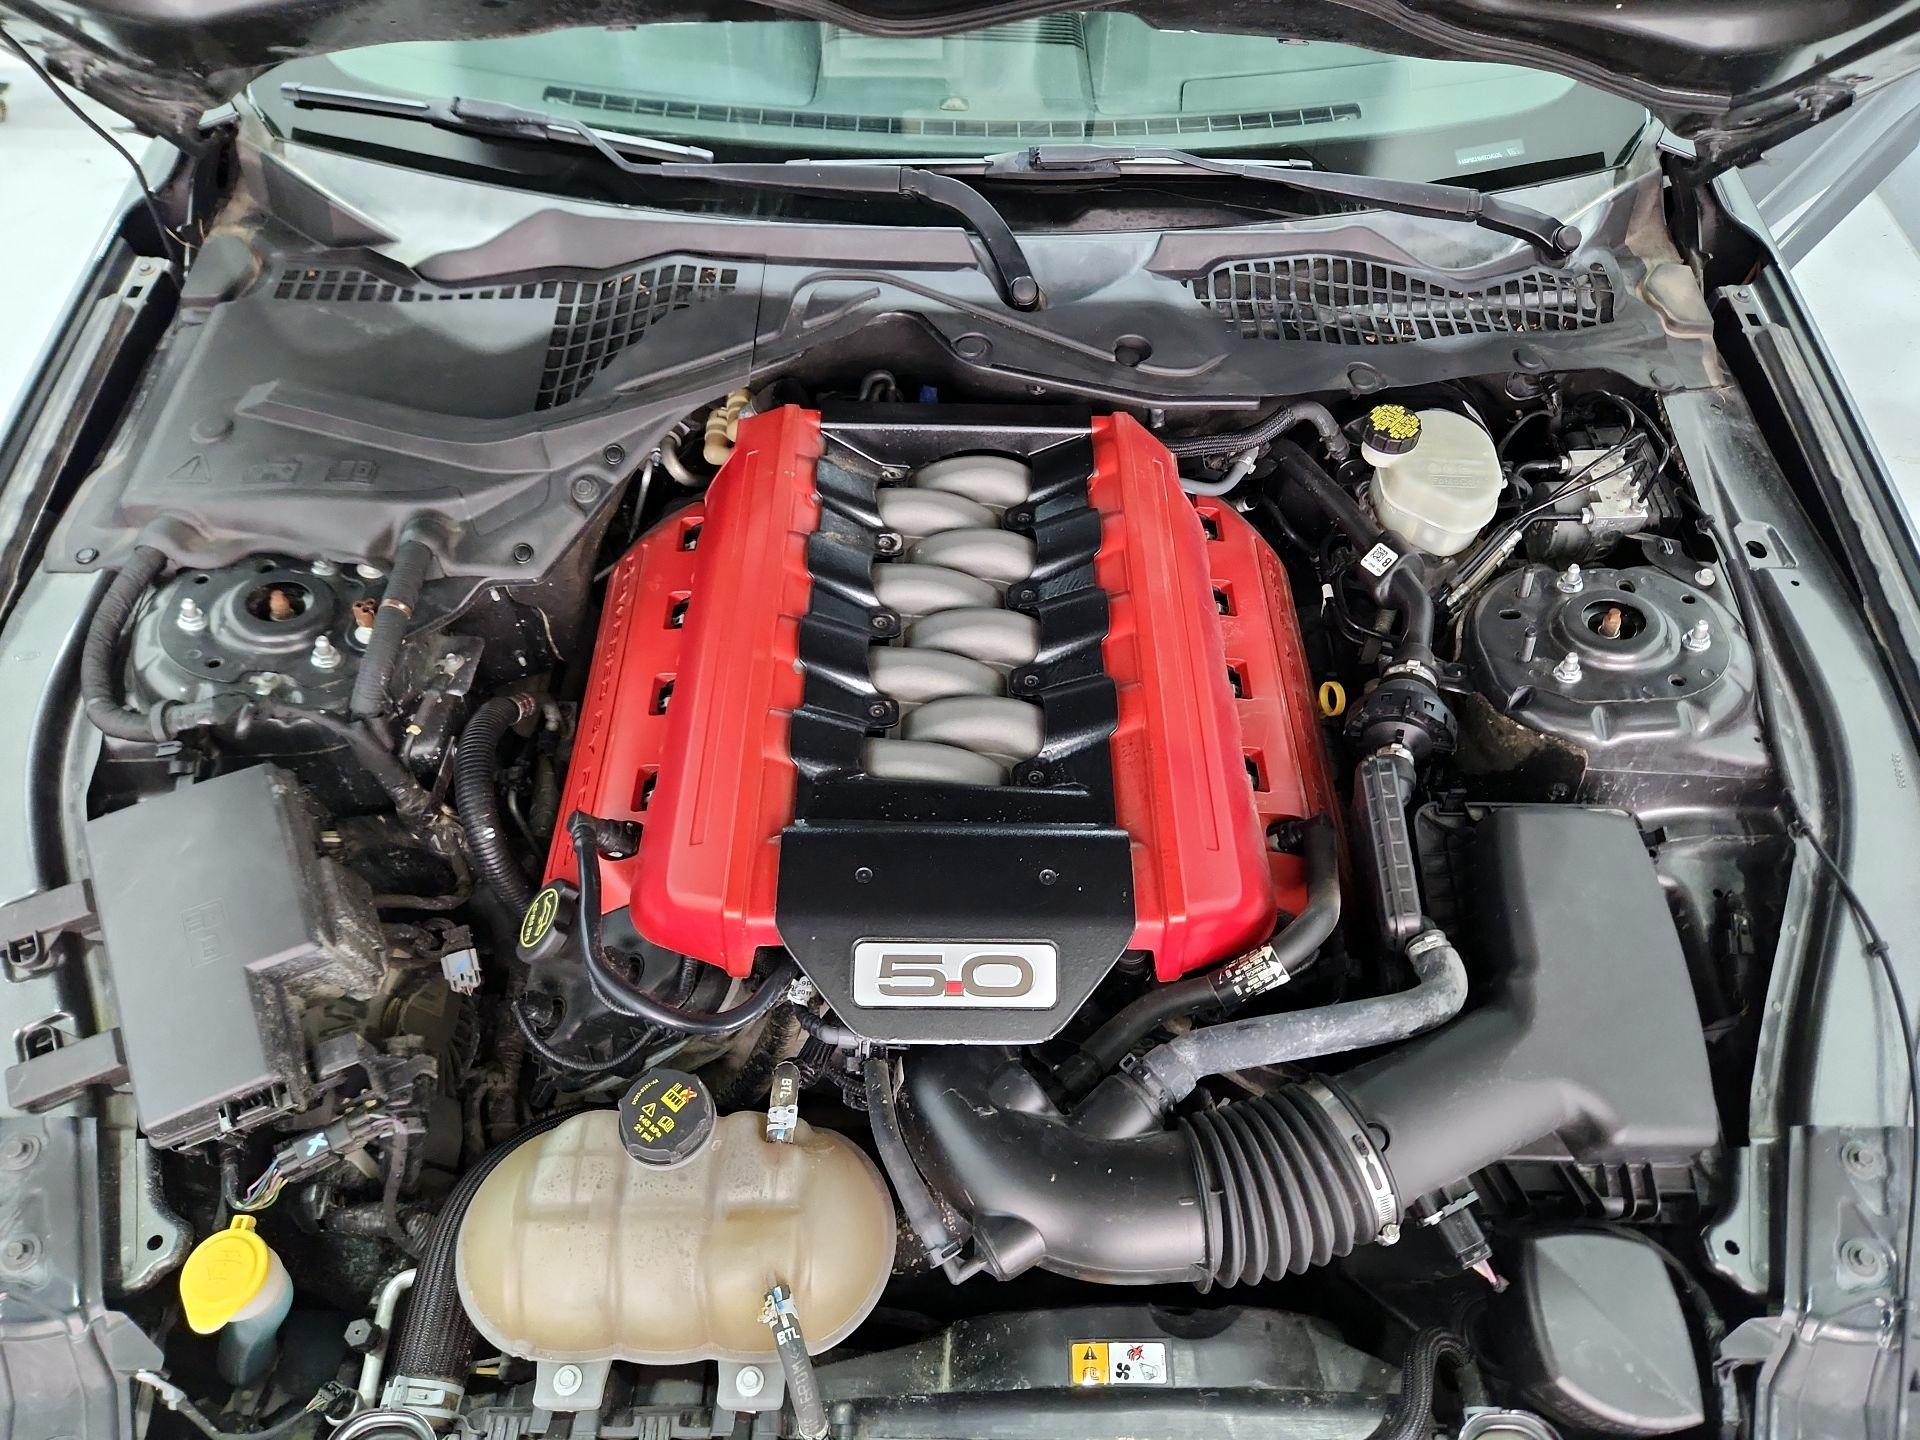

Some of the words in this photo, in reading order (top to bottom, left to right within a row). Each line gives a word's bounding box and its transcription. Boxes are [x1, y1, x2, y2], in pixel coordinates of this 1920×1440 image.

[1382, 557, 1393, 567] B
[600, 555, 636, 699] POWERED
[588, 709, 604, 753] BY
[877, 953, 1035, 998] 5.0
[780, 1078, 793, 1098] BTL
[633, 1123, 645, 1133] 21
[640, 1131, 655, 1143] psi
[638, 1114, 652, 1127] 145
[648, 1124, 662, 1138] kPa
[776, 1326, 800, 1346] BTL
